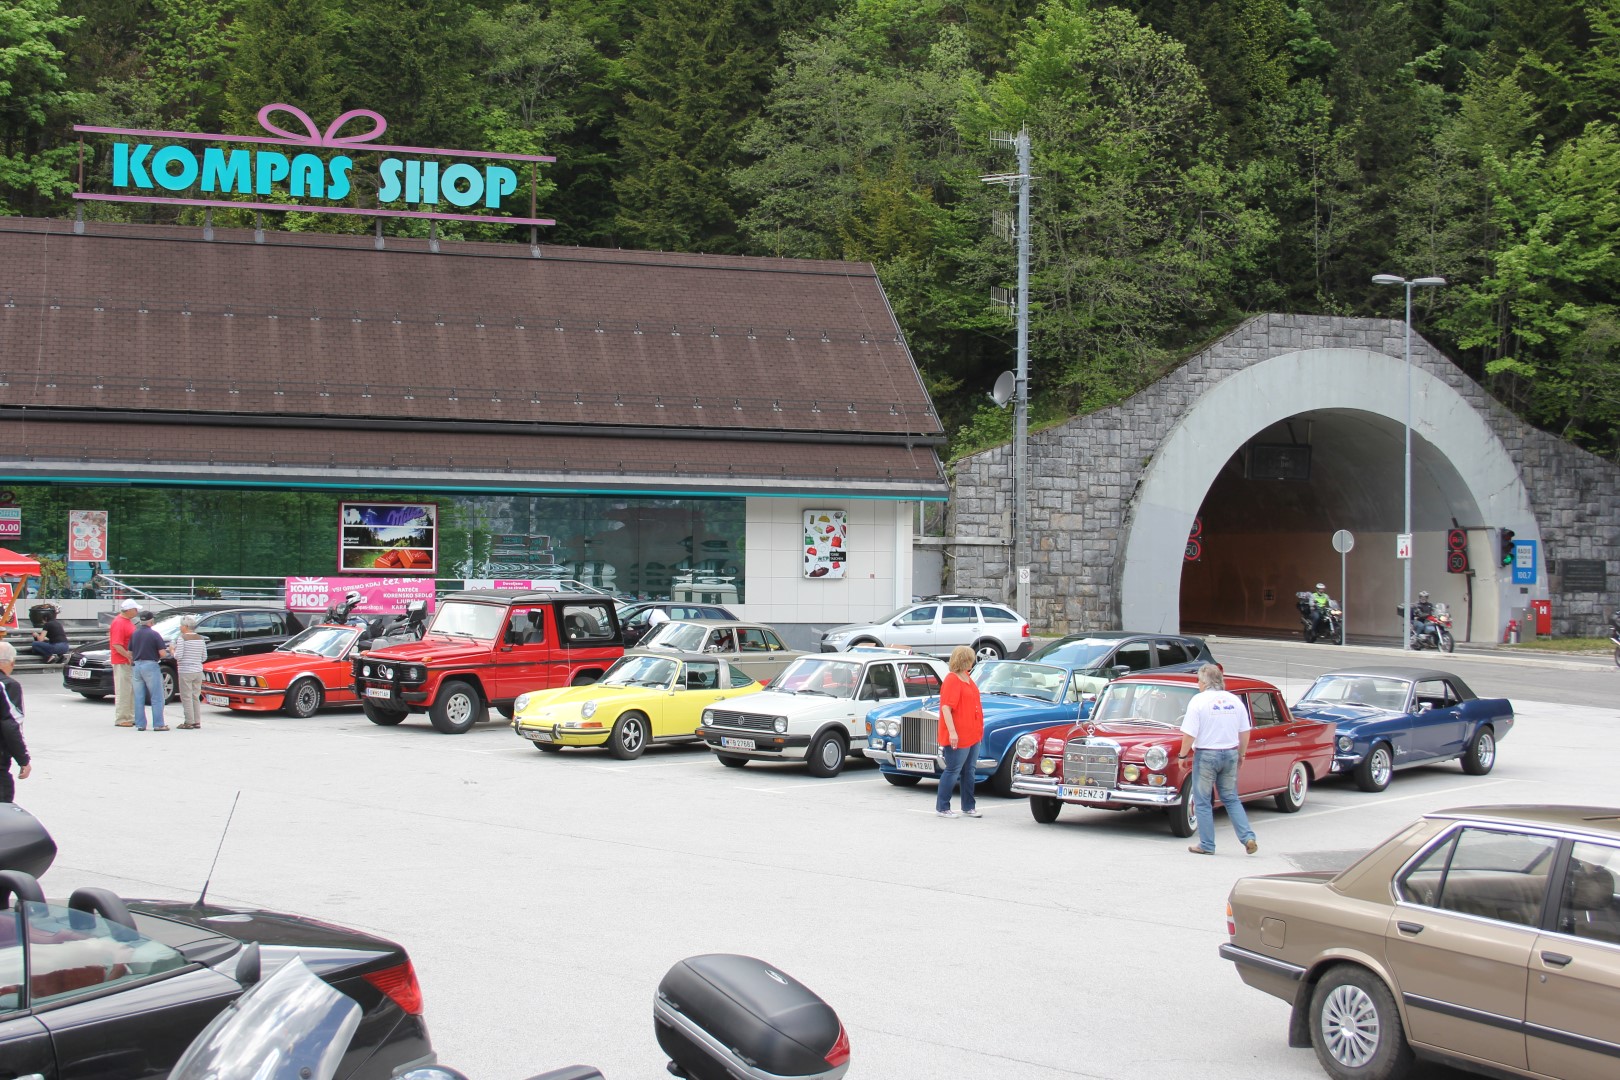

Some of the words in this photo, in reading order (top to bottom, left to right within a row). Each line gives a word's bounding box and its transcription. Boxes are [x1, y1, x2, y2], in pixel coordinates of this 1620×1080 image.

[113, 142, 353, 200] KOMPAS
[378, 158, 517, 209] SHOP
[1185, 544, 1198, 556] 50
[1452, 557, 1463, 568] 50
[290, 585, 329, 593] KOMPAS
[290, 593, 329, 607] SHOP
[1539, 605, 1547, 614] H
[1062, 787, 1073, 796] OW
[1078, 789, 1098, 799] BENZ
[1099, 790, 1105, 799] 3
